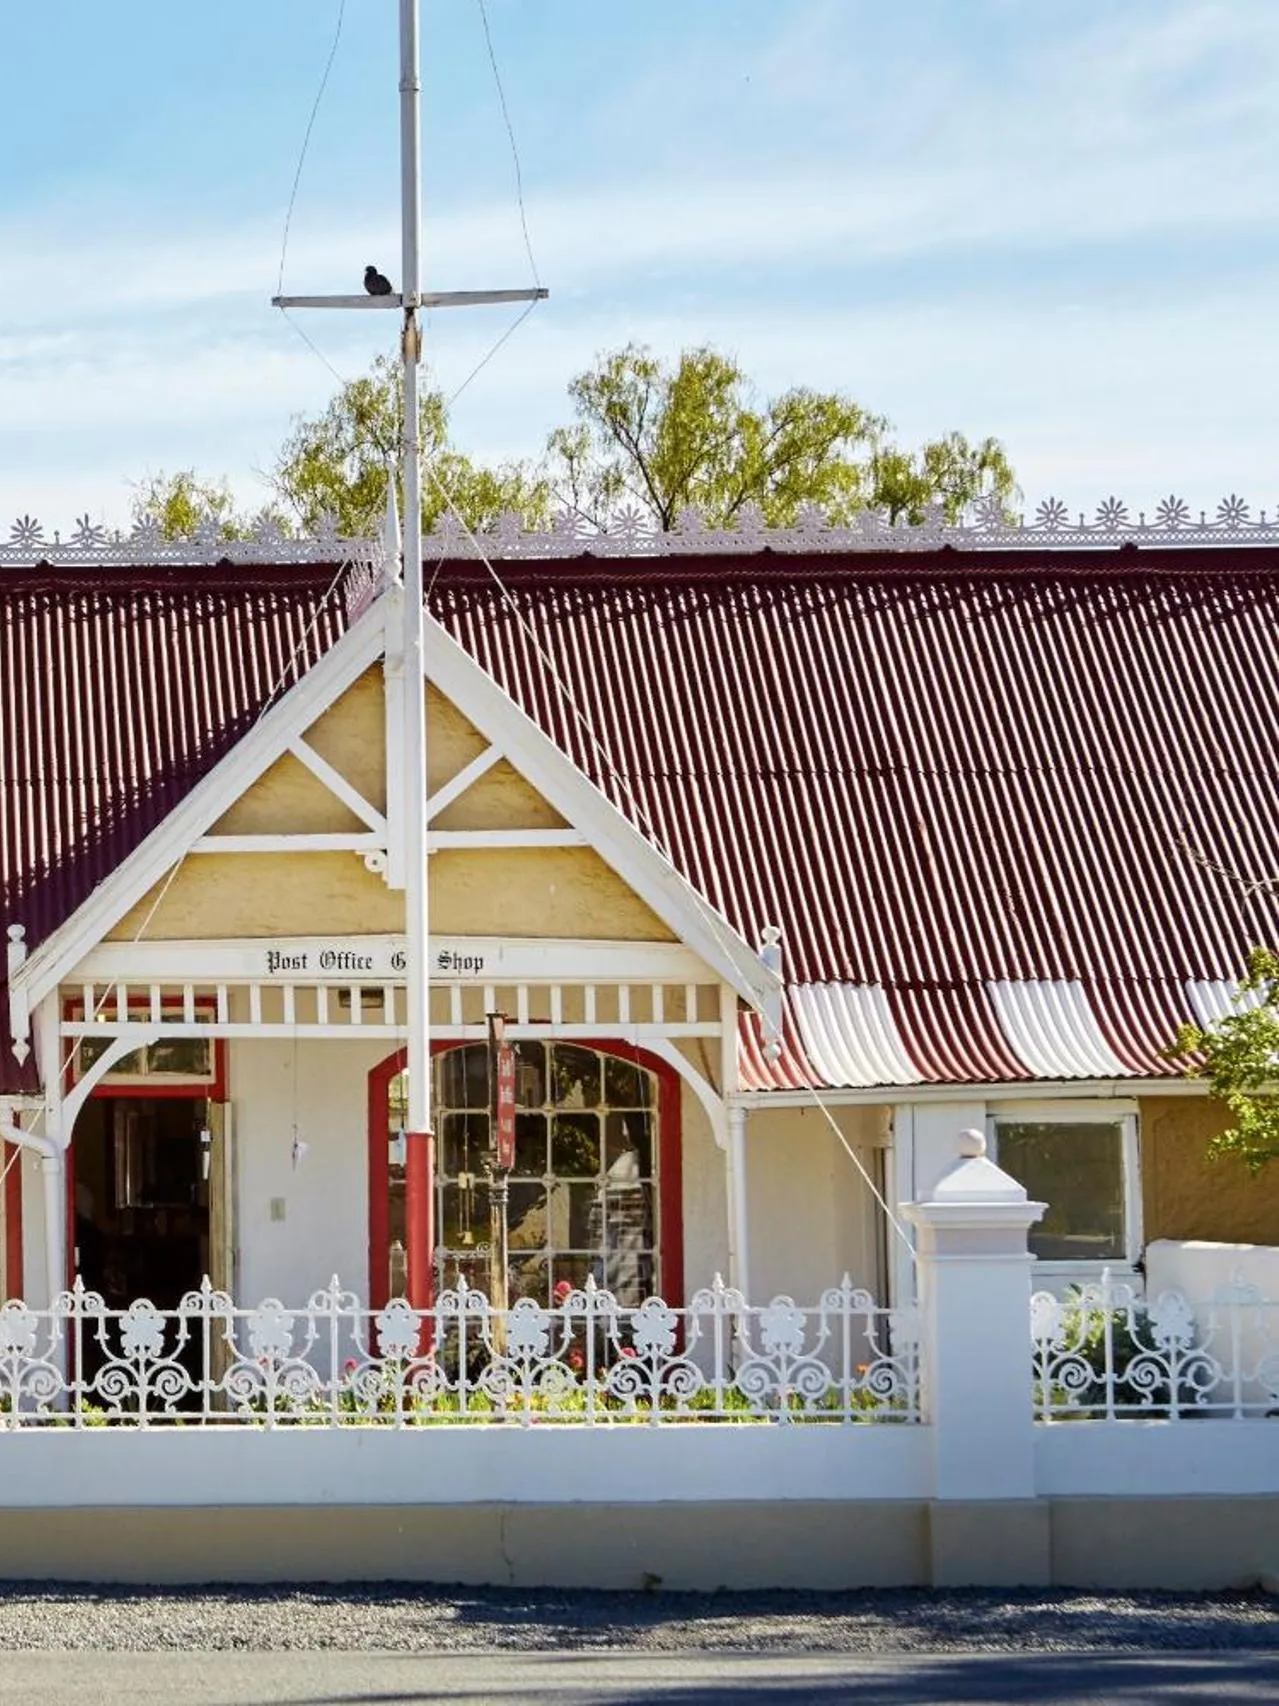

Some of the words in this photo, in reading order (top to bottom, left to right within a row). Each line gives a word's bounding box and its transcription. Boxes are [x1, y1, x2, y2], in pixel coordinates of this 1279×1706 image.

[267, 951, 308, 974] Post
[319, 949, 373, 971] Office
[437, 950, 485, 975] Shop
